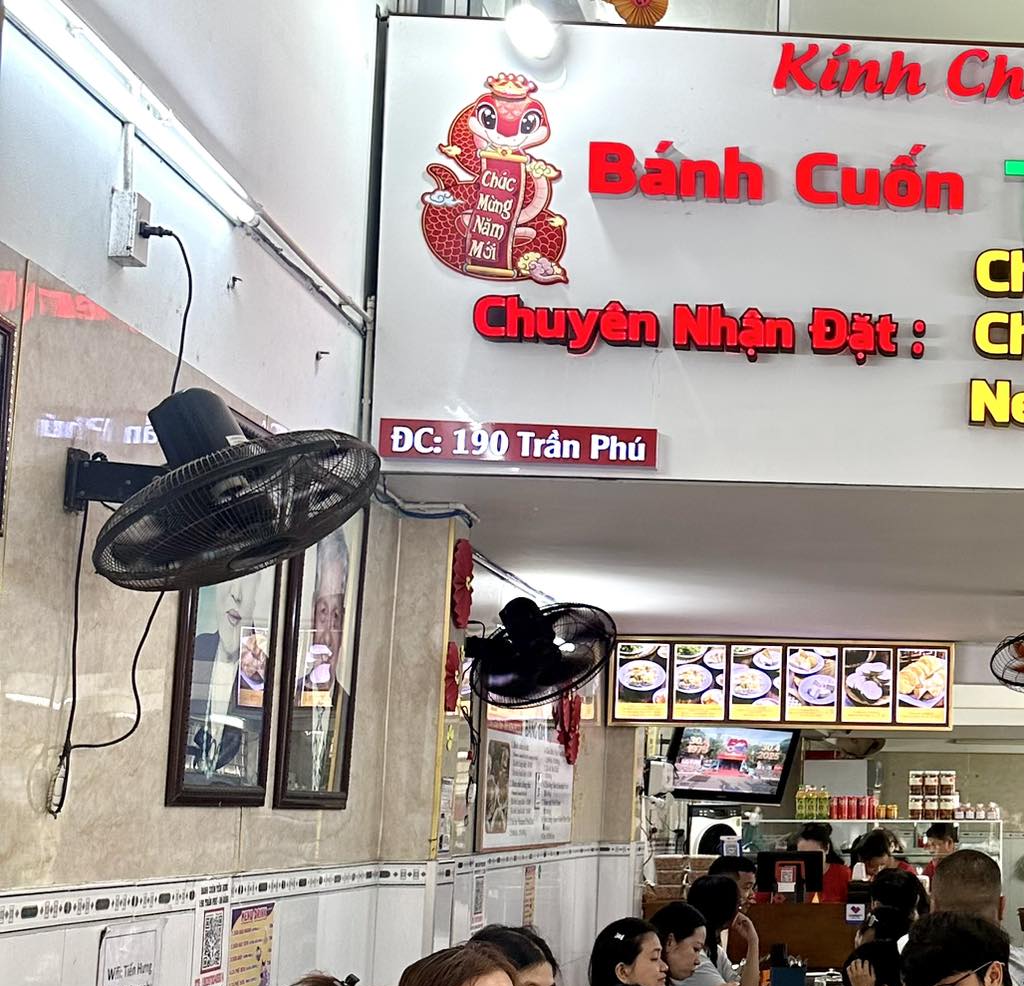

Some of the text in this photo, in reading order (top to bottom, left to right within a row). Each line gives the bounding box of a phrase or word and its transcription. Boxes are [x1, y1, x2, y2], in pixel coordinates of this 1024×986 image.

[772, 42, 927, 97] Kính
[481, 170, 517, 192] Chúc
[588, 140, 965, 213] Bánh Cuốn
[477, 193, 513, 220] Mừng
[472, 215, 505, 241] Năm
[468, 240, 497, 260] Mới
[473, 294, 659, 356] Chuyên
[673, 303, 795, 362] Nhận
[808, 307, 898, 364] Đặt
[391, 427, 646, 461] ĐC: 190 Trần Phú
